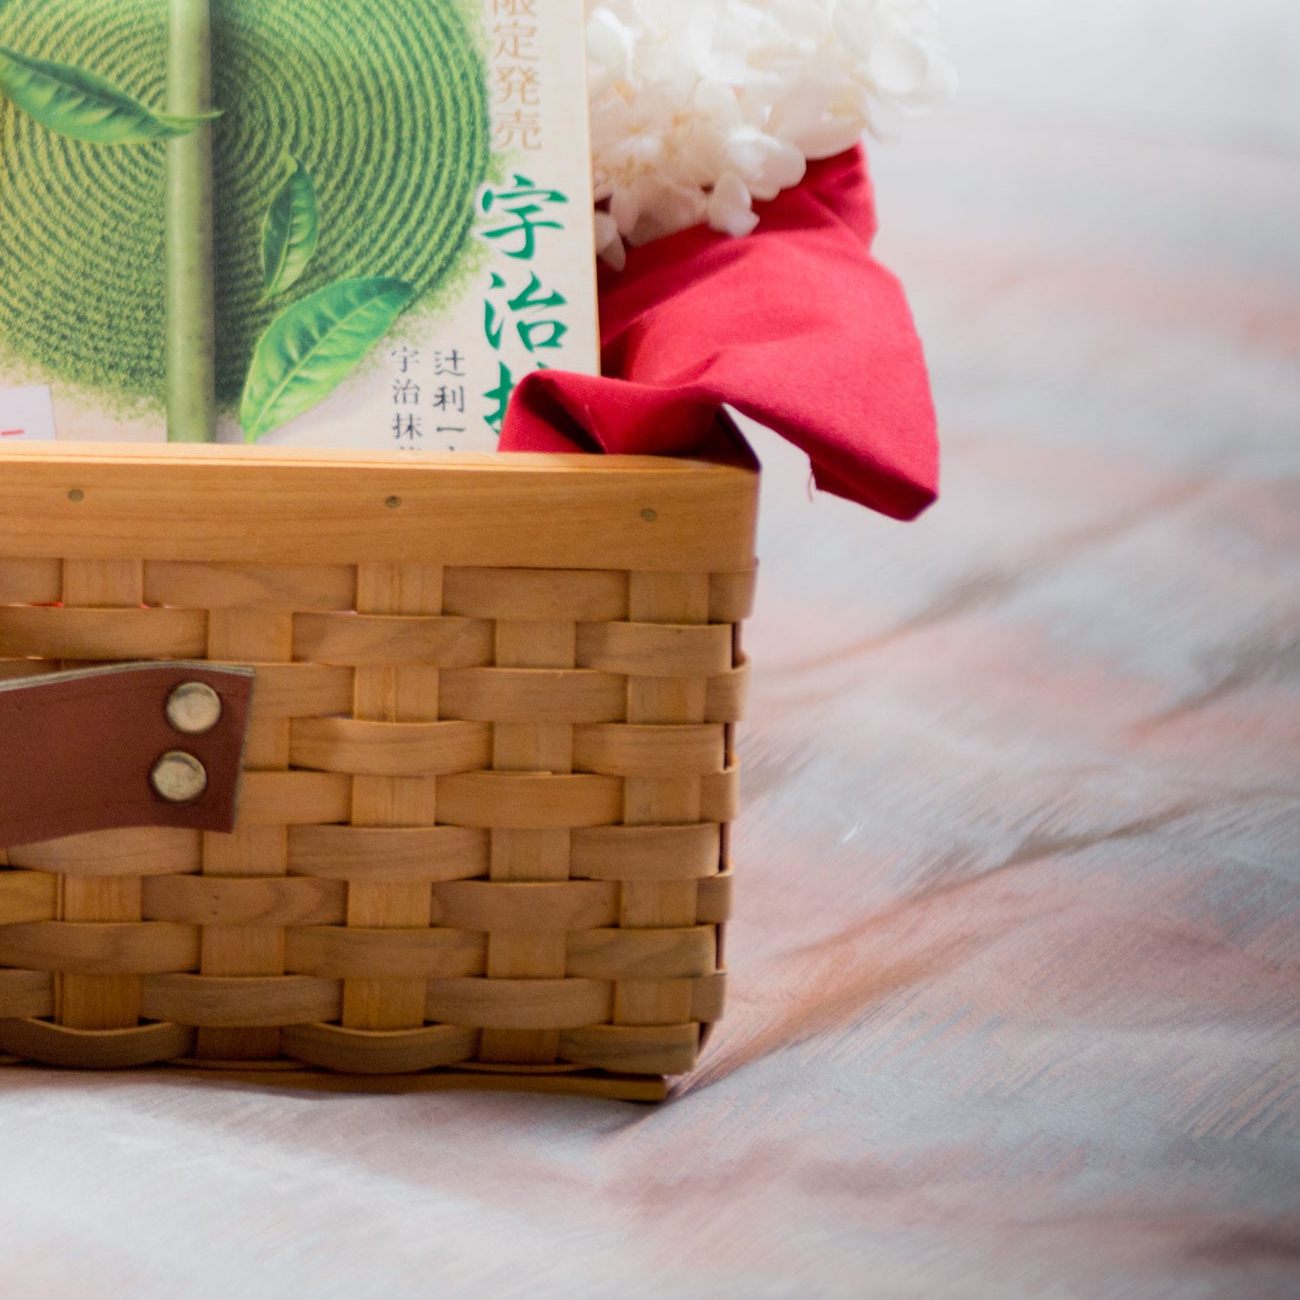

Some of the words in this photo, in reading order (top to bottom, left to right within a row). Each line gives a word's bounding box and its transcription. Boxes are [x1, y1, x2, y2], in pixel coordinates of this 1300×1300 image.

[392, 347, 423, 451] 宇治抹
[433, 349, 467, 451] 辻利一
